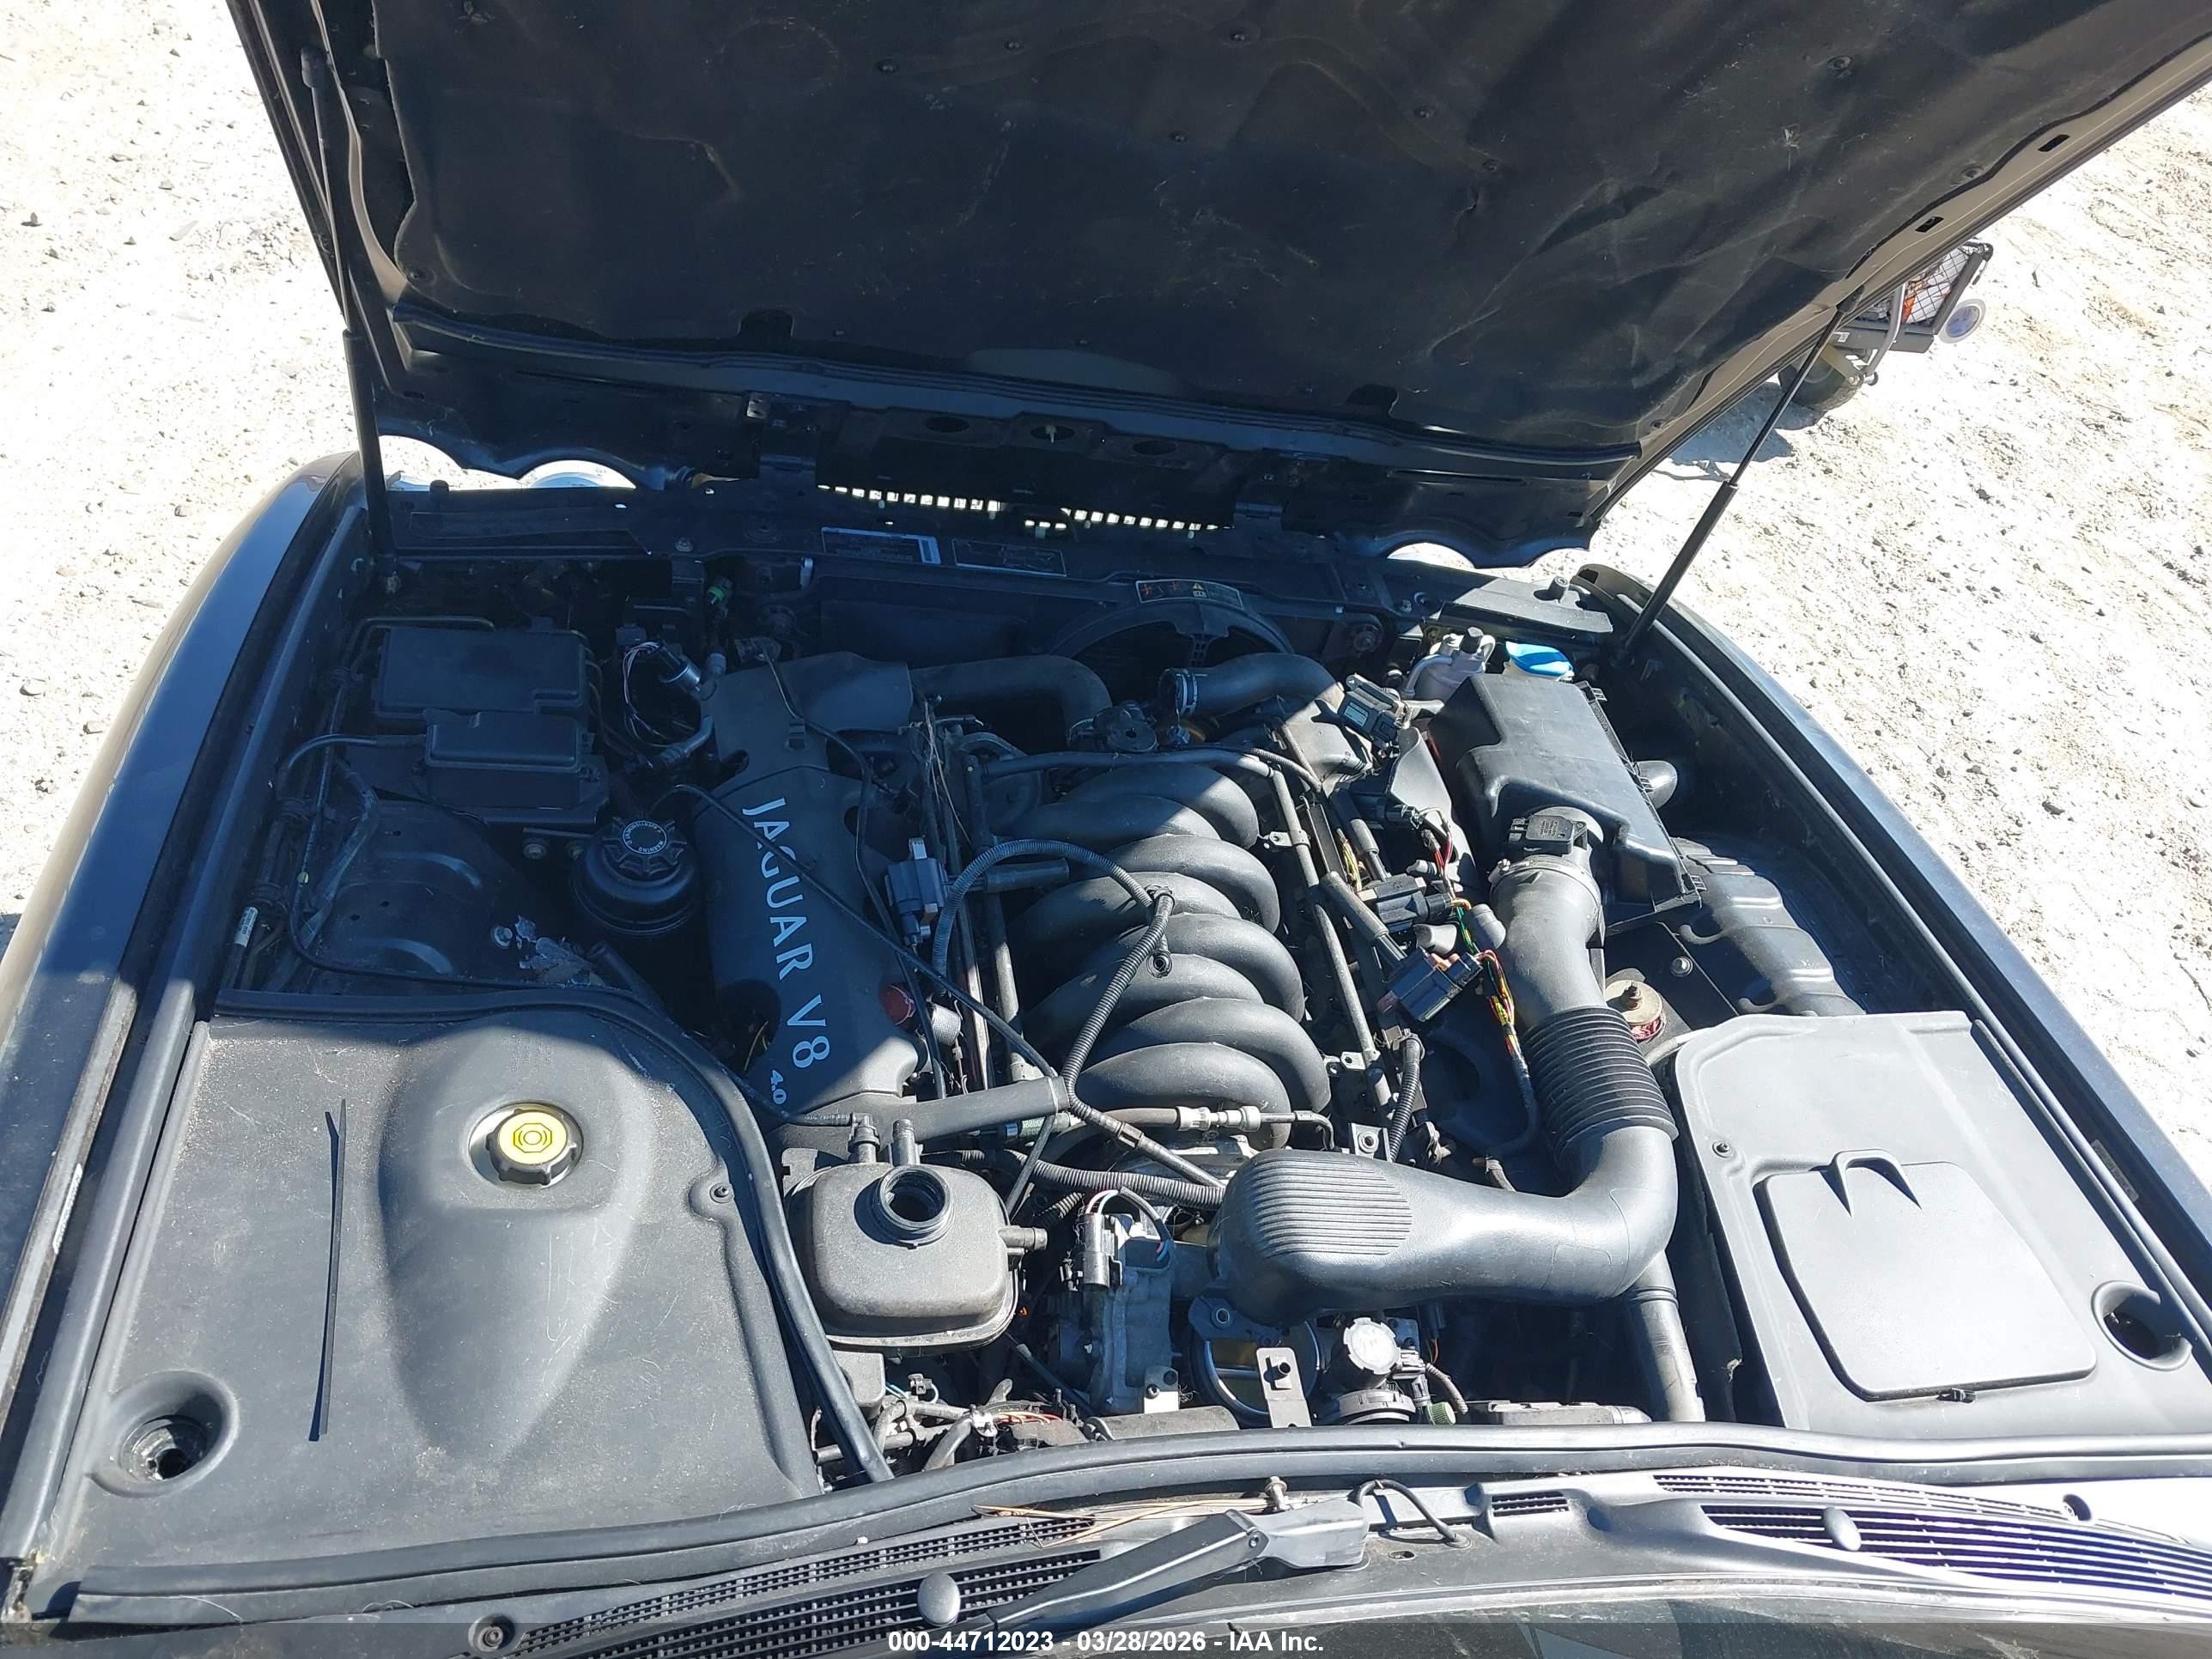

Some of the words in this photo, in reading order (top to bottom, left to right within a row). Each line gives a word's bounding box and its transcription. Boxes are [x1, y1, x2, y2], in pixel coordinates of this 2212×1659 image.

[742, 797, 813, 981] JAGUAR
[787, 994, 830, 1069] V8
[770, 1069, 787, 1105] 4.0
